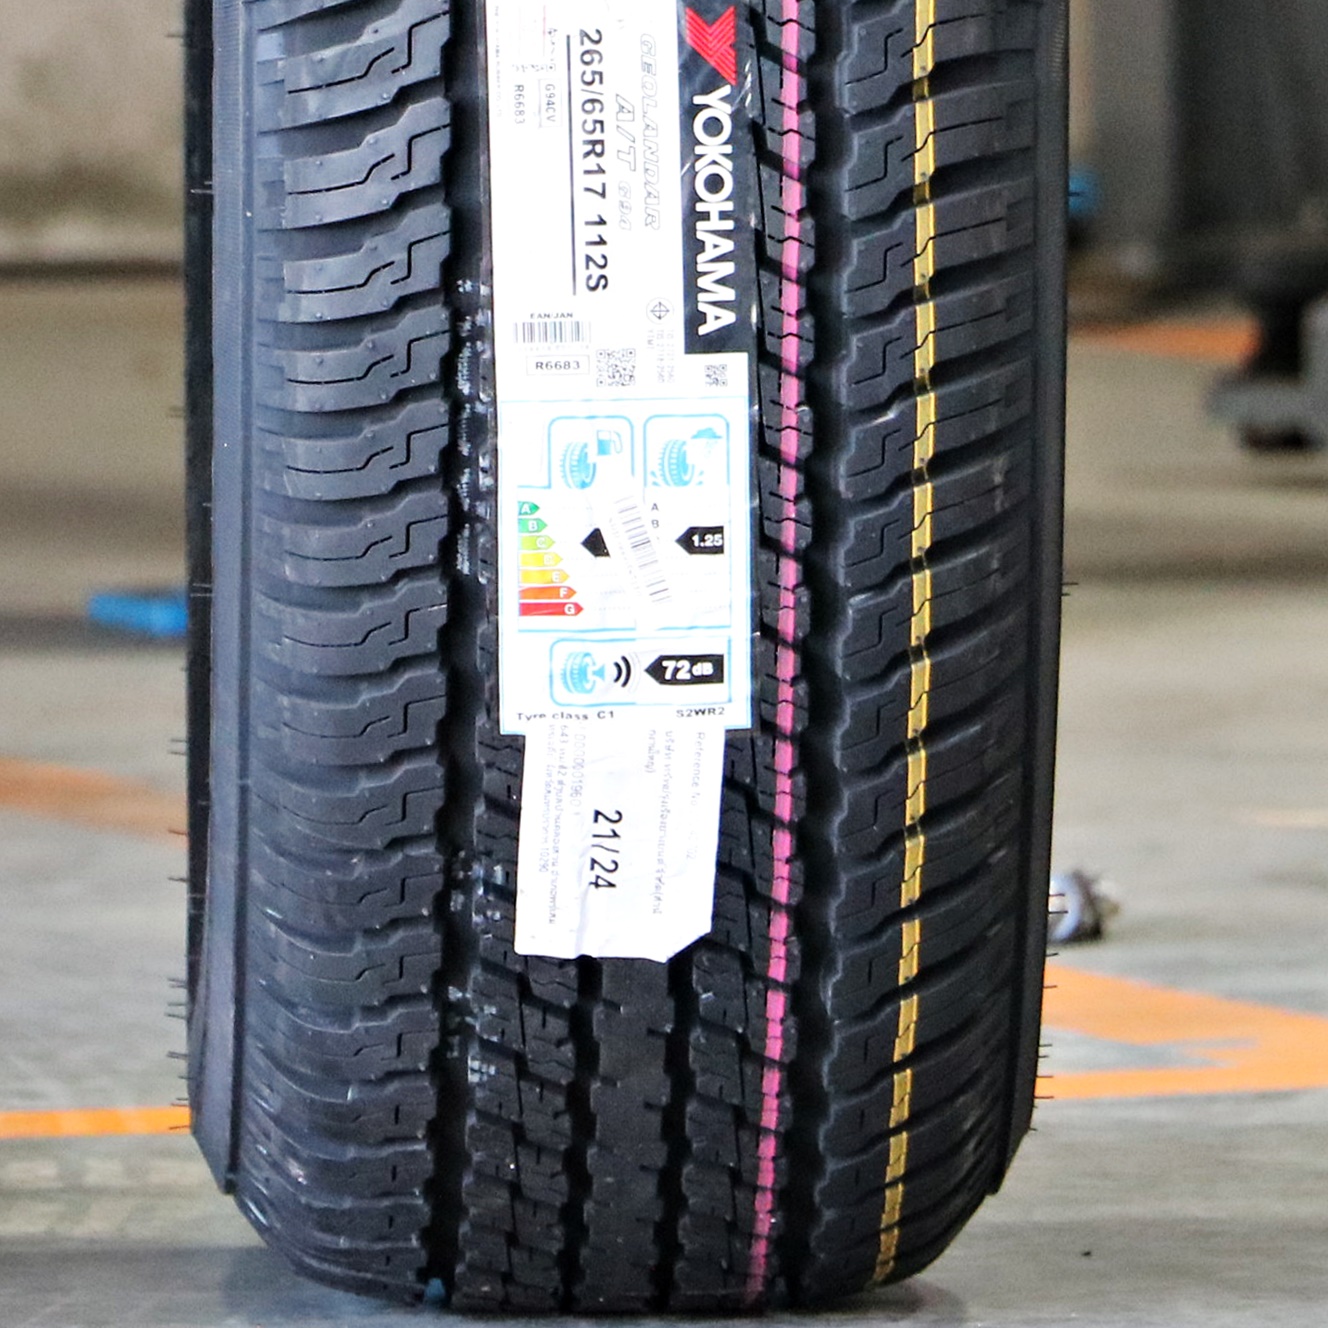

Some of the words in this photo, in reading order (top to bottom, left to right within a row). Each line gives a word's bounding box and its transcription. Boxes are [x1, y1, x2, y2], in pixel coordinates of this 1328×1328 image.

[514, 84, 525, 125] R6683
[544, 83, 556, 122] G94CV
[579, 28, 607, 199] 265/65R17
[615, 93, 636, 172] A/T
[640, 33, 661, 230] GEOLANDAR
[692, 84, 736, 336] YOKOHAMA
[584, 213, 609, 293] 112S
[535, 360, 580, 370] R6683
[521, 504, 531, 513] A
[651, 503, 659, 511] A
[528, 521, 538, 531] B
[651, 520, 660, 529] B
[692, 534, 723, 546] 1.25
[559, 588, 567, 598] F
[565, 604, 575, 615] G
[517, 712, 546, 721] Tyre
[552, 711, 589, 721] class
[597, 710, 614, 719] C1
[676, 706, 726, 718] S2WR2
[691, 731, 706, 788] Reference
[588, 809, 623, 890] 21/24
